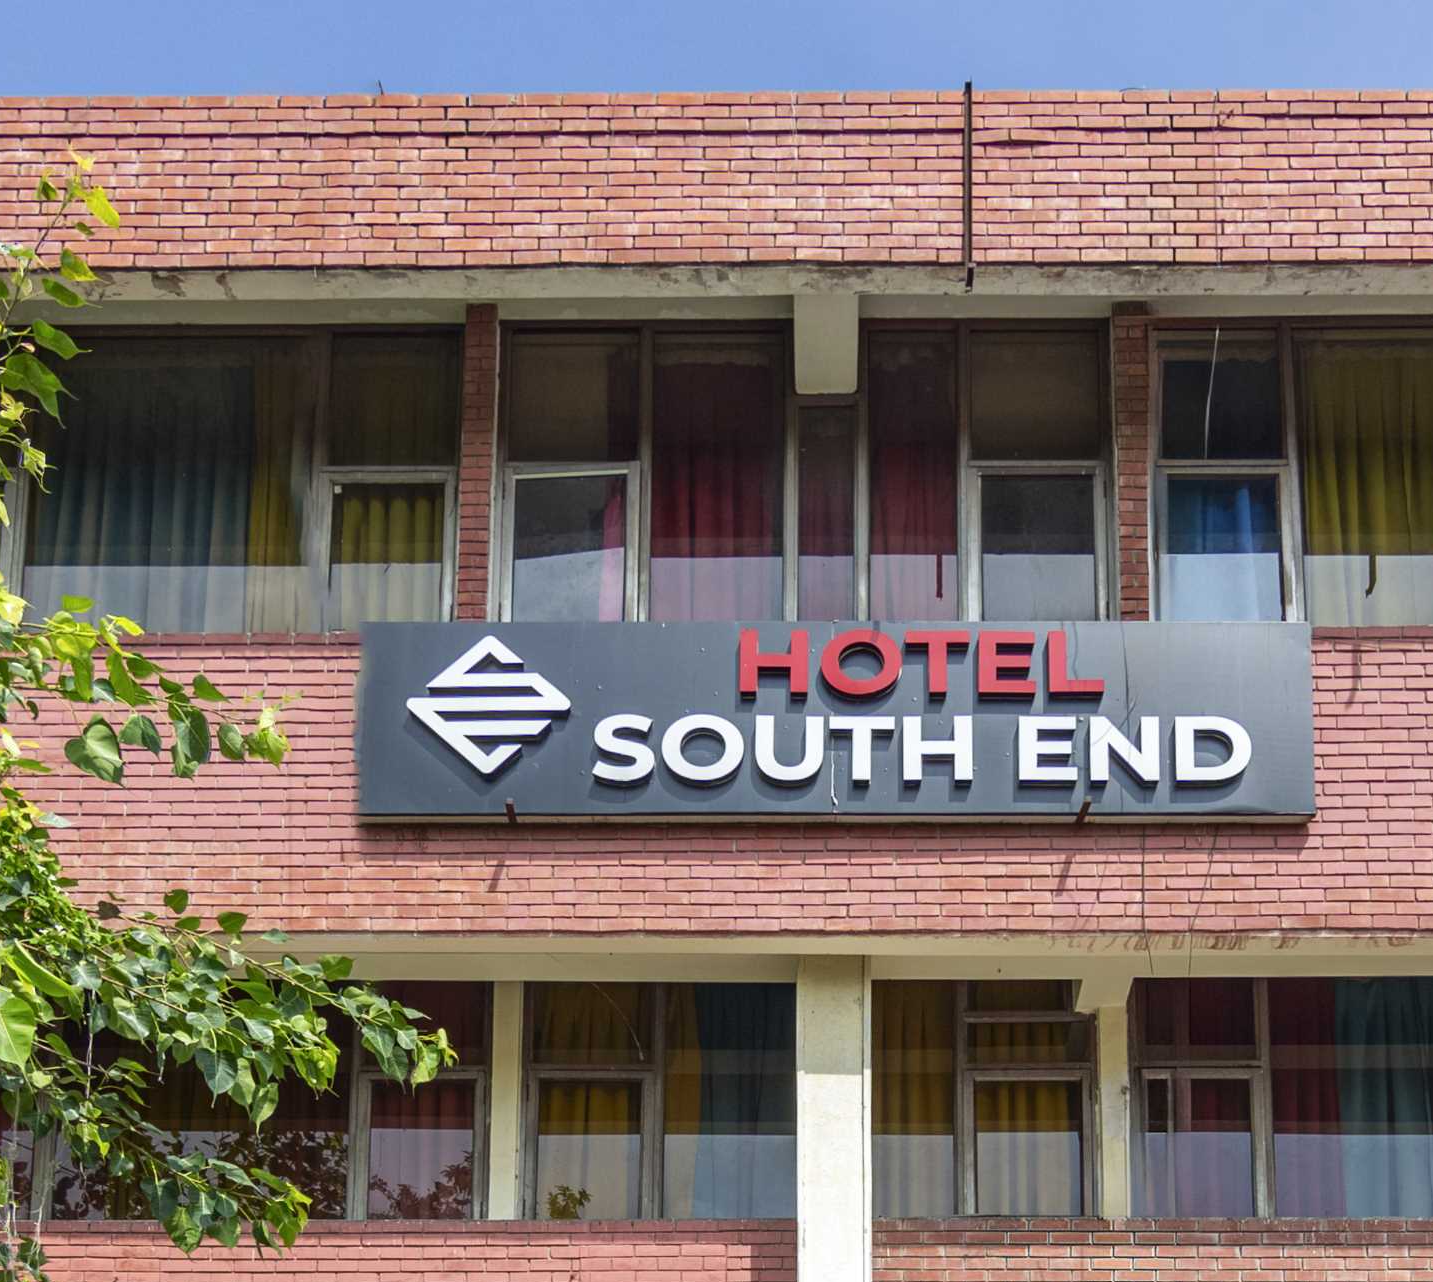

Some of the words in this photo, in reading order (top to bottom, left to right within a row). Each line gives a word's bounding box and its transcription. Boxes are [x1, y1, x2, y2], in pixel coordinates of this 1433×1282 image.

[739, 628, 1105, 700] HOTEL
[592, 713, 975, 788] SOUTH
[1017, 715, 1253, 787] END
